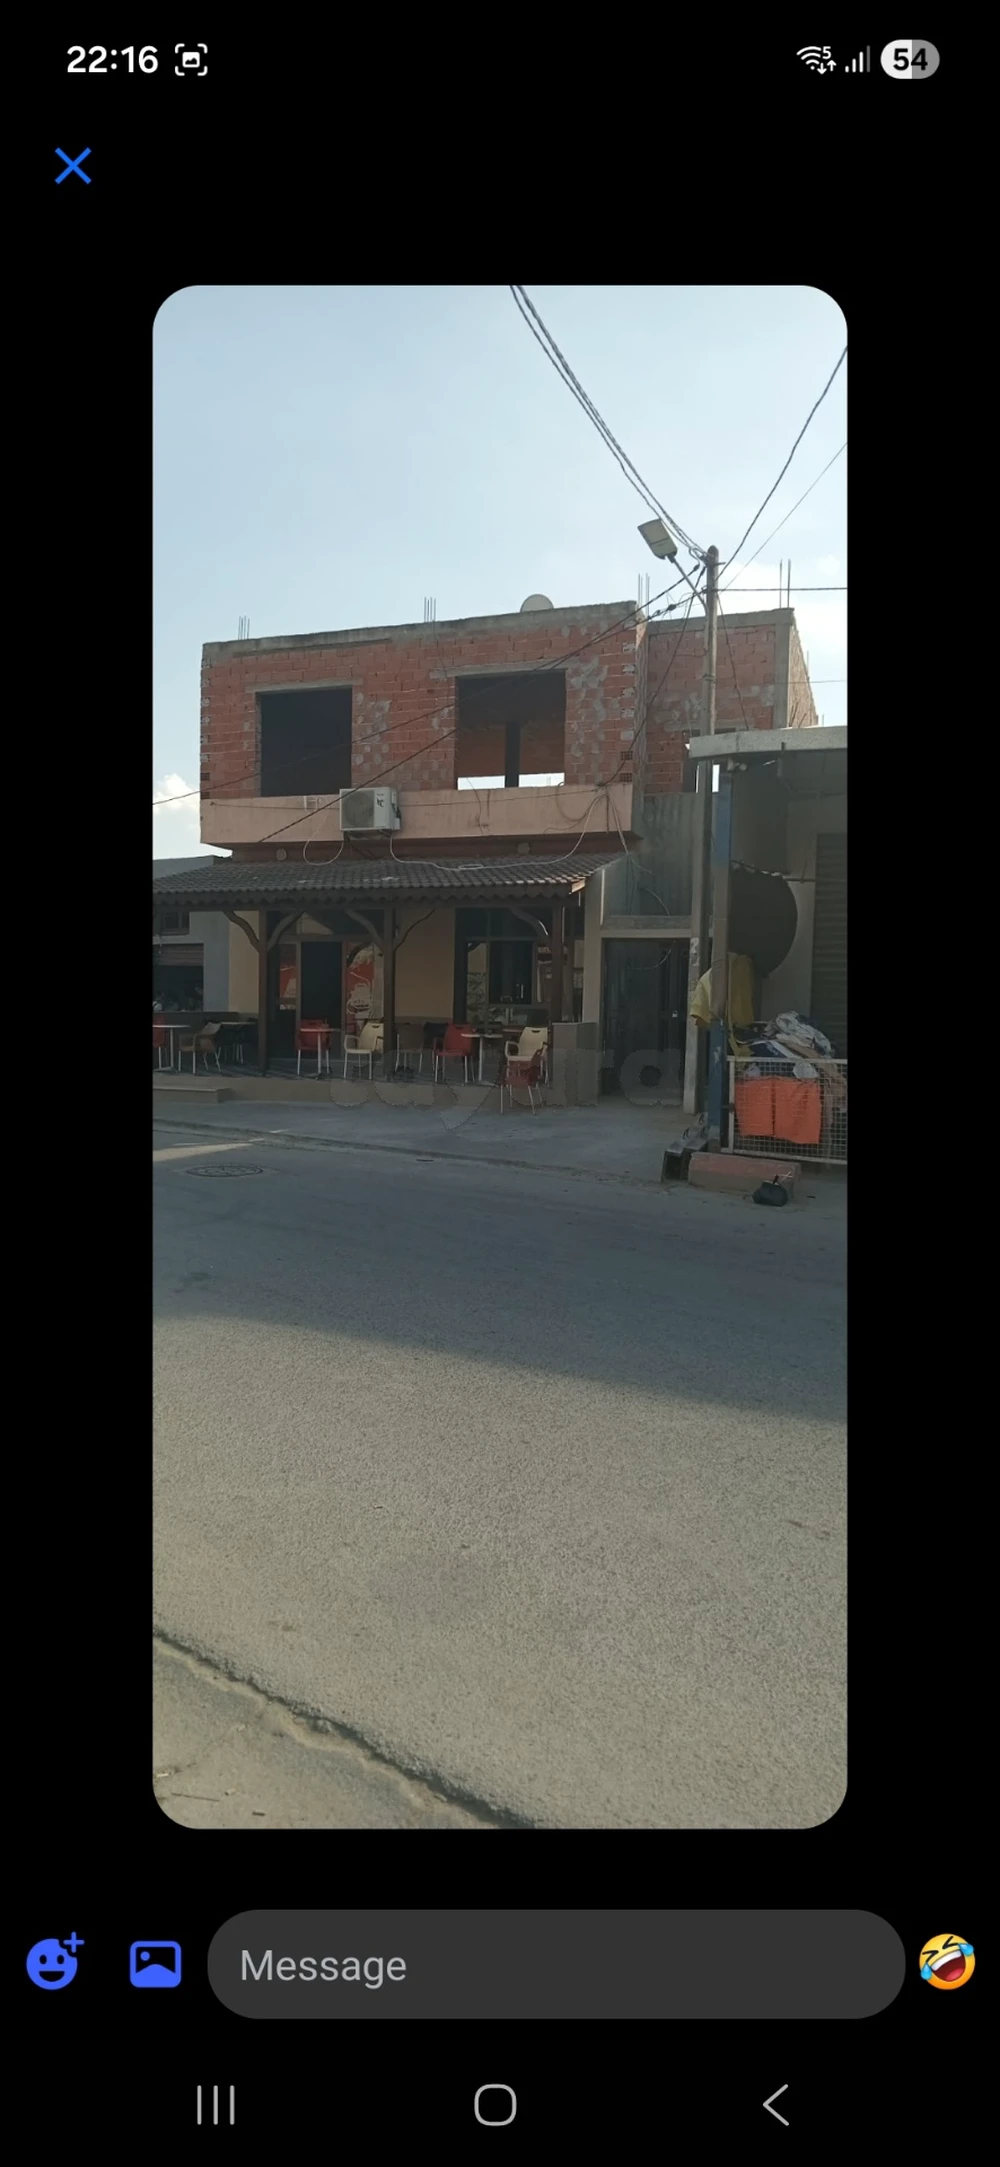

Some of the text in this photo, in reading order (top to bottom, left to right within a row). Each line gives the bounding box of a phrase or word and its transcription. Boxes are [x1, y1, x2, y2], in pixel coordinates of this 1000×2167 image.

[67, 46, 158, 73] 22:16
[822, 46, 832, 60] 5
[893, 48, 928, 71] 54
[242, 1950, 407, 1989] Message
